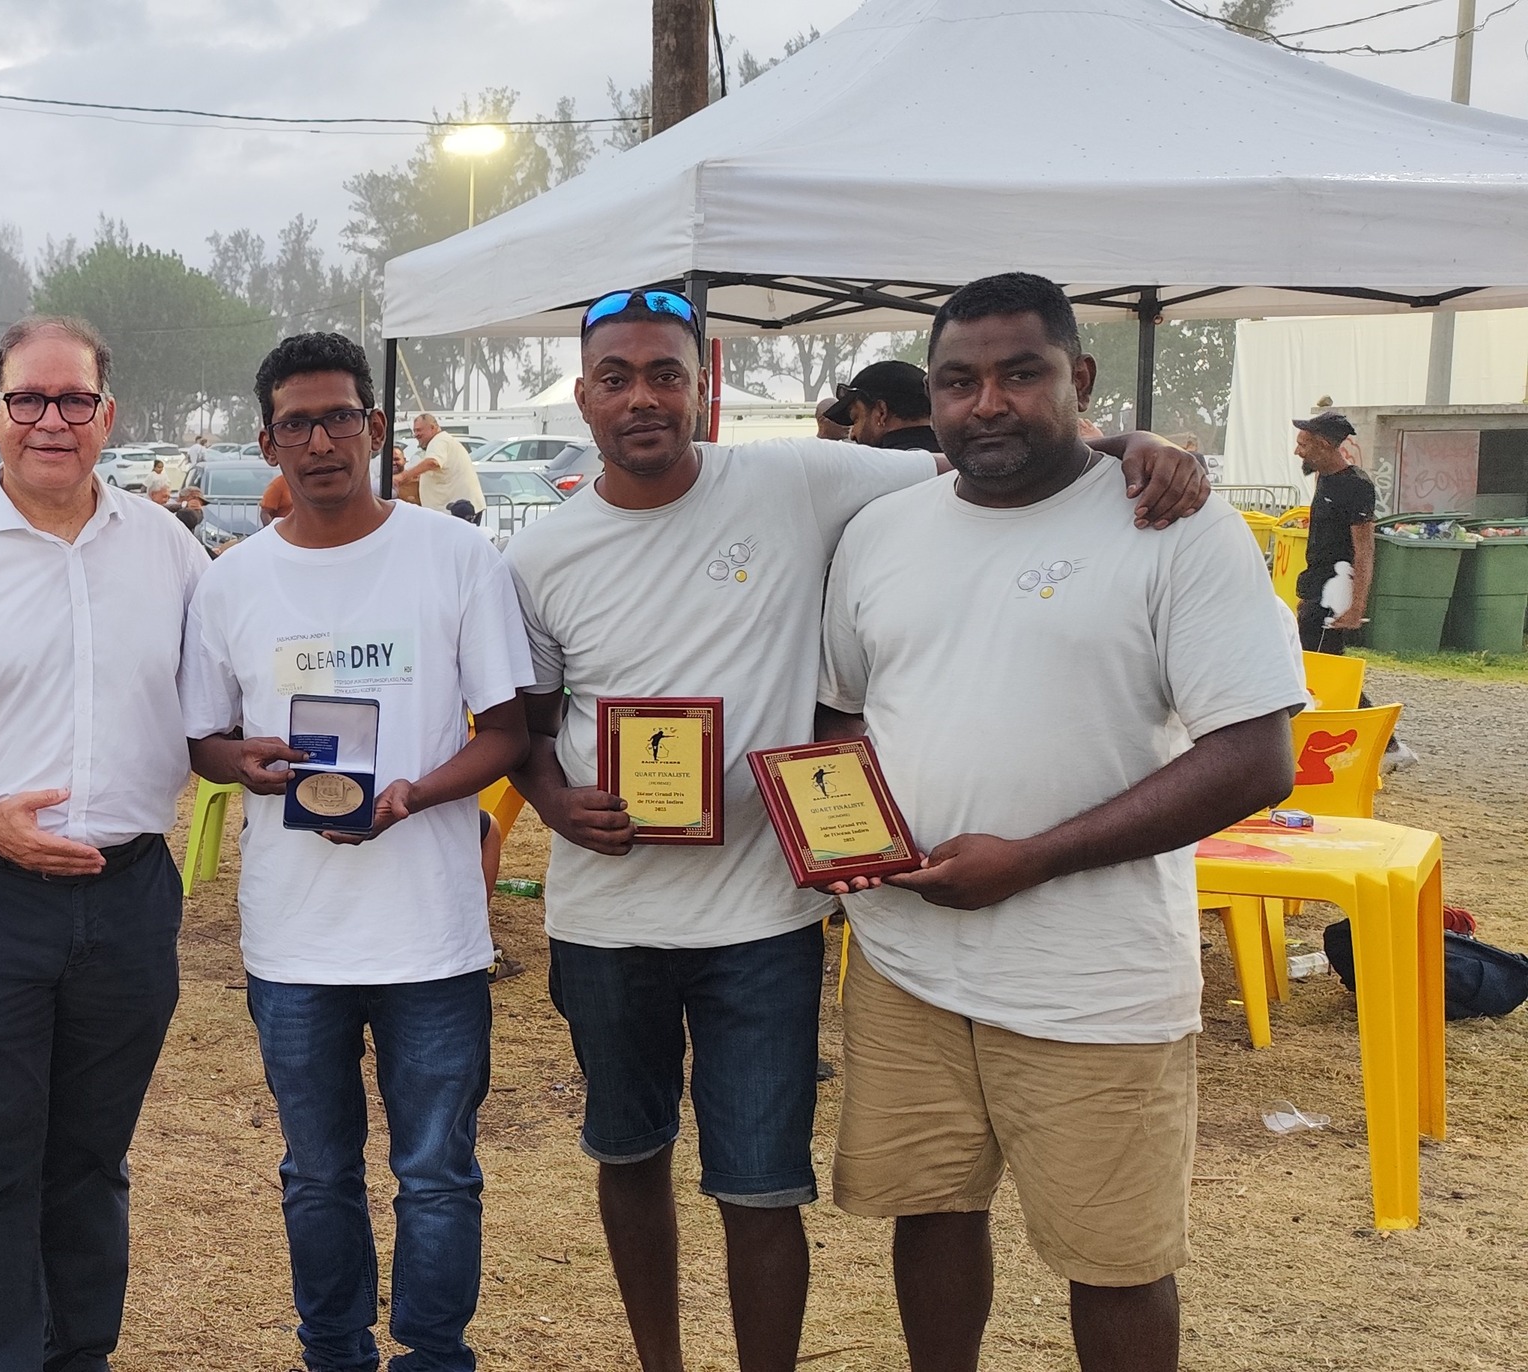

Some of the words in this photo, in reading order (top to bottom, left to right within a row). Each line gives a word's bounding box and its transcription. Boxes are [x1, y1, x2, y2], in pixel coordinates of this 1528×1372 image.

[296, 650, 346, 671] CLEAR
[350, 642, 394, 669] DRY
[810, 806, 832, 814] QUART
[833, 801, 866, 811] FINALISTE
